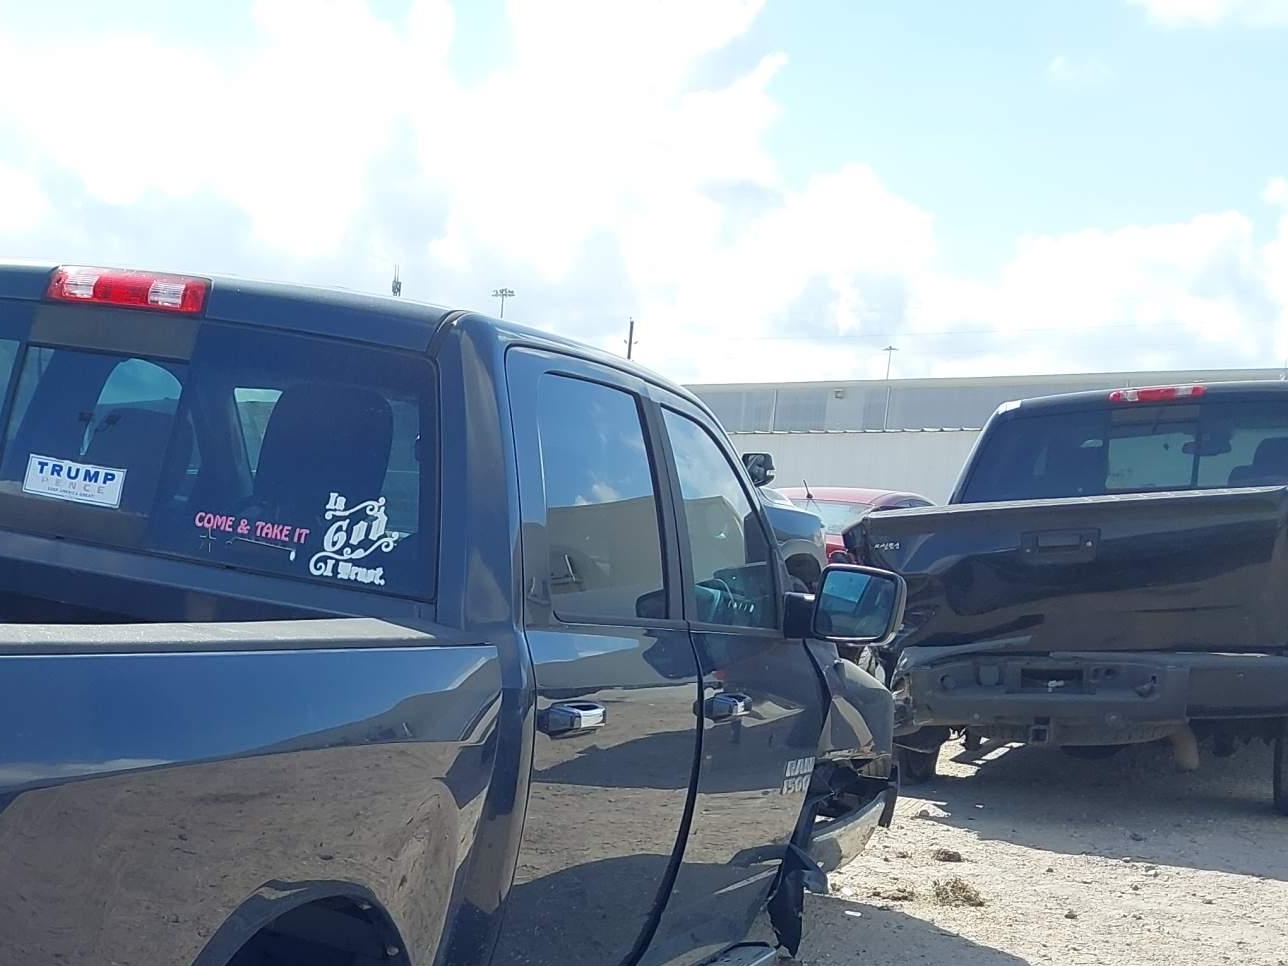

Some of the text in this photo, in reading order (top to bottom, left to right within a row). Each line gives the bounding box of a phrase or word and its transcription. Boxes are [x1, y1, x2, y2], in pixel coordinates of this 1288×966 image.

[37, 461, 116, 485] TRUMP
[41, 477, 106, 495] PENCE
[325, 493, 347, 511] In
[194, 512, 311, 545] COME & TAKE IT
[323, 507, 388, 552] God
[785, 757, 815, 777] RAM
